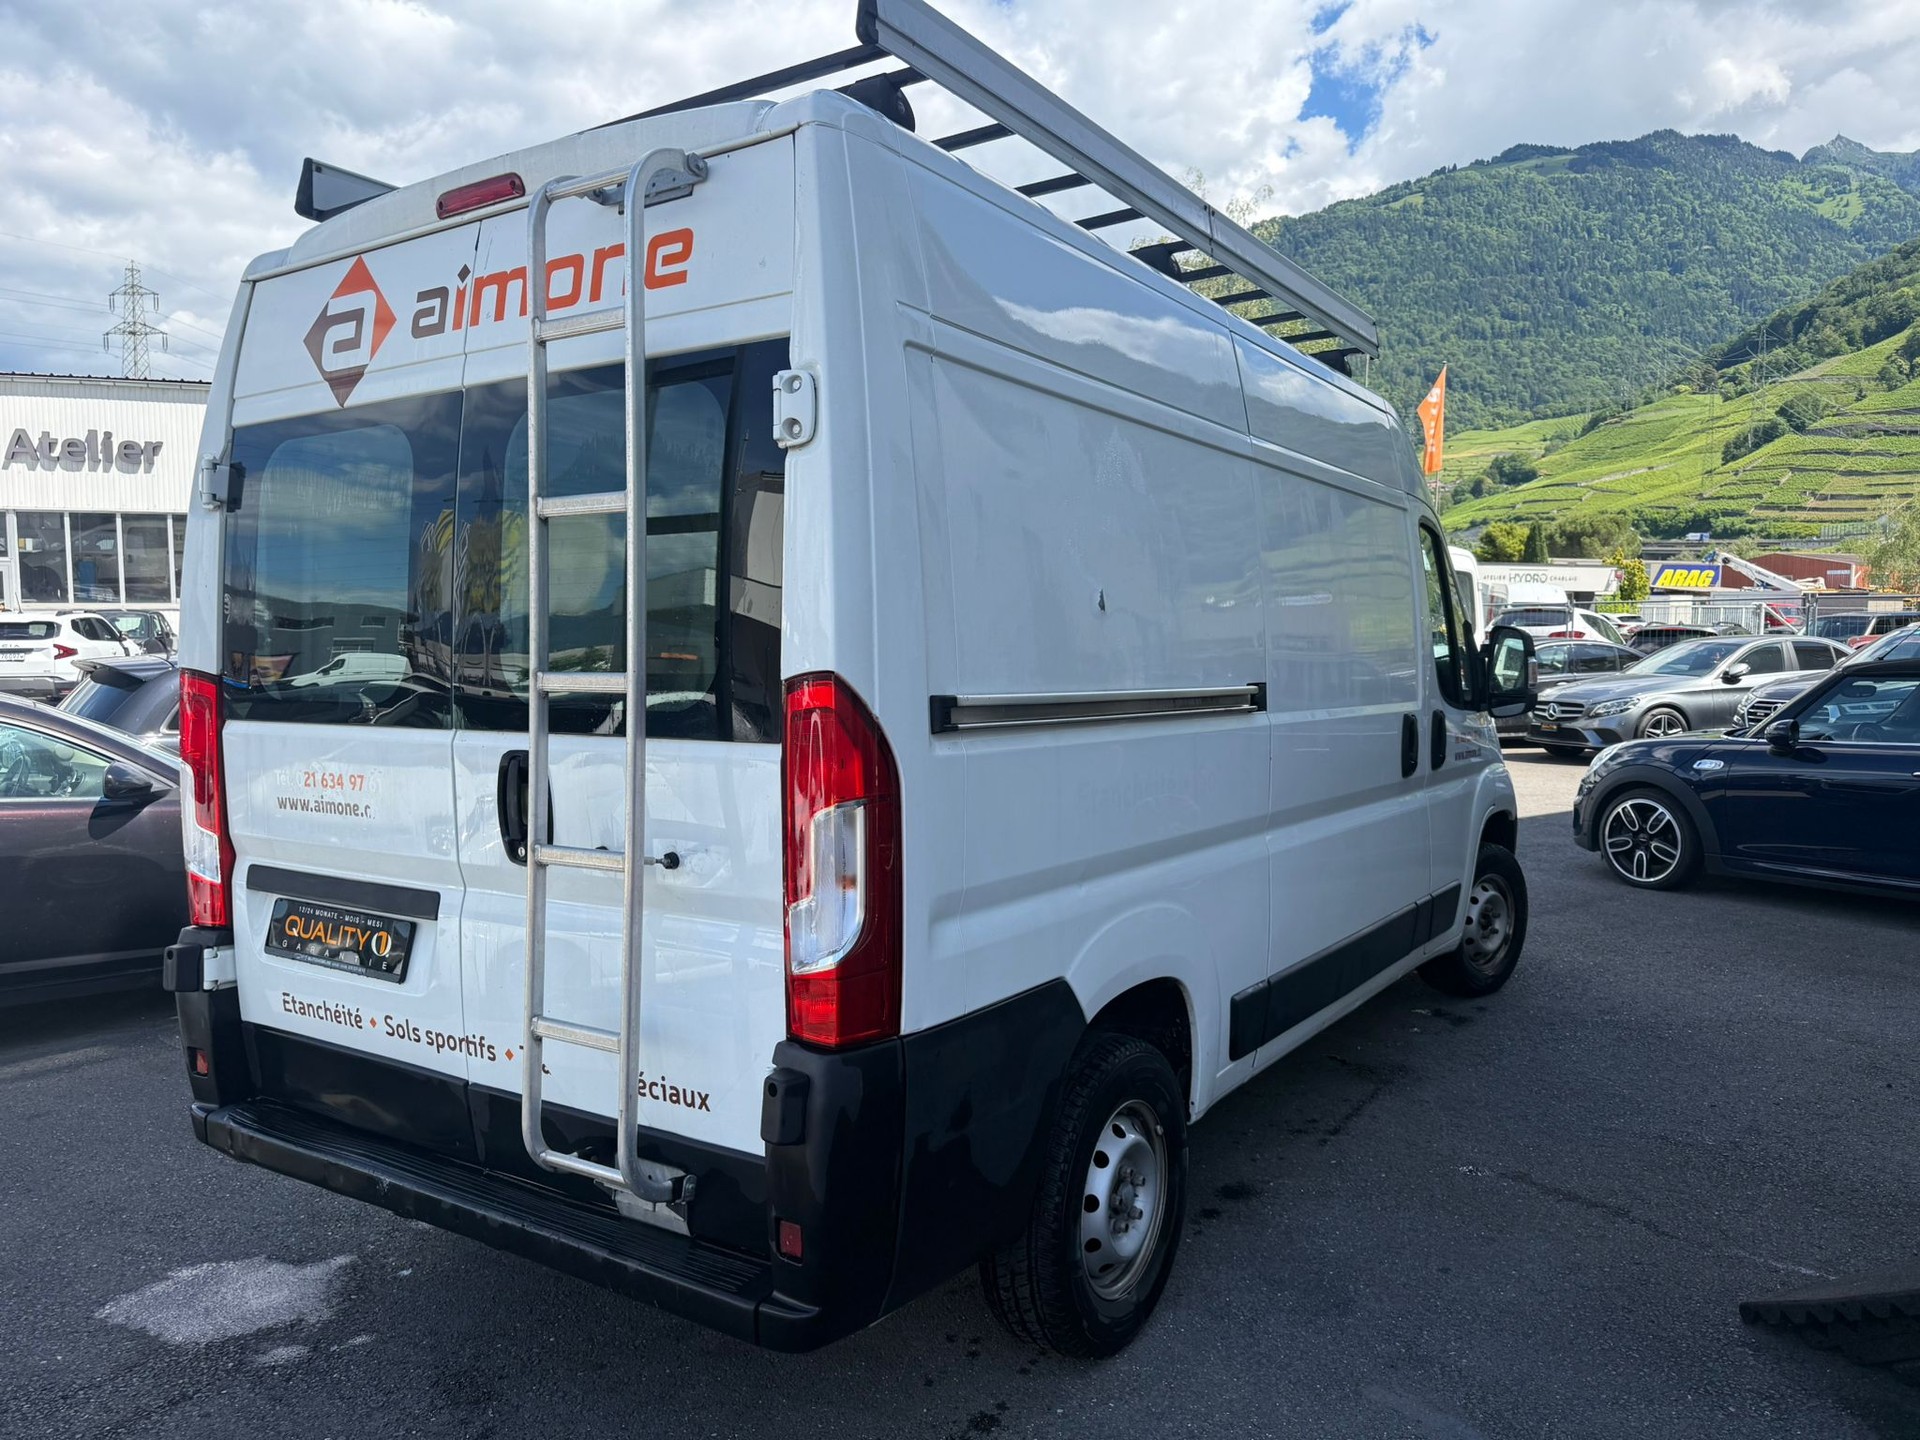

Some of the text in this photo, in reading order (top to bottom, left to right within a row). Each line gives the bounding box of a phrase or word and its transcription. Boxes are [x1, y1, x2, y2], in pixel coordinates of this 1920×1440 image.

[410, 227, 694, 339] aimone
[5, 428, 163, 468] Atelier
[1656, 568, 1716, 587] ARAG
[320, 772, 345, 790] 634
[348, 774, 365, 791] 97
[285, 915, 371, 950] QUALITY
[315, 909, 338, 919] MONATE
[344, 915, 360, 924] MOIS
[367, 919, 384, 928] MESI
[281, 939, 388, 970] GARANTIE
[384, 1015, 421, 1043] Sols
[426, 1028, 497, 1061] sportifs
[637, 1071, 711, 1112] éciaux
